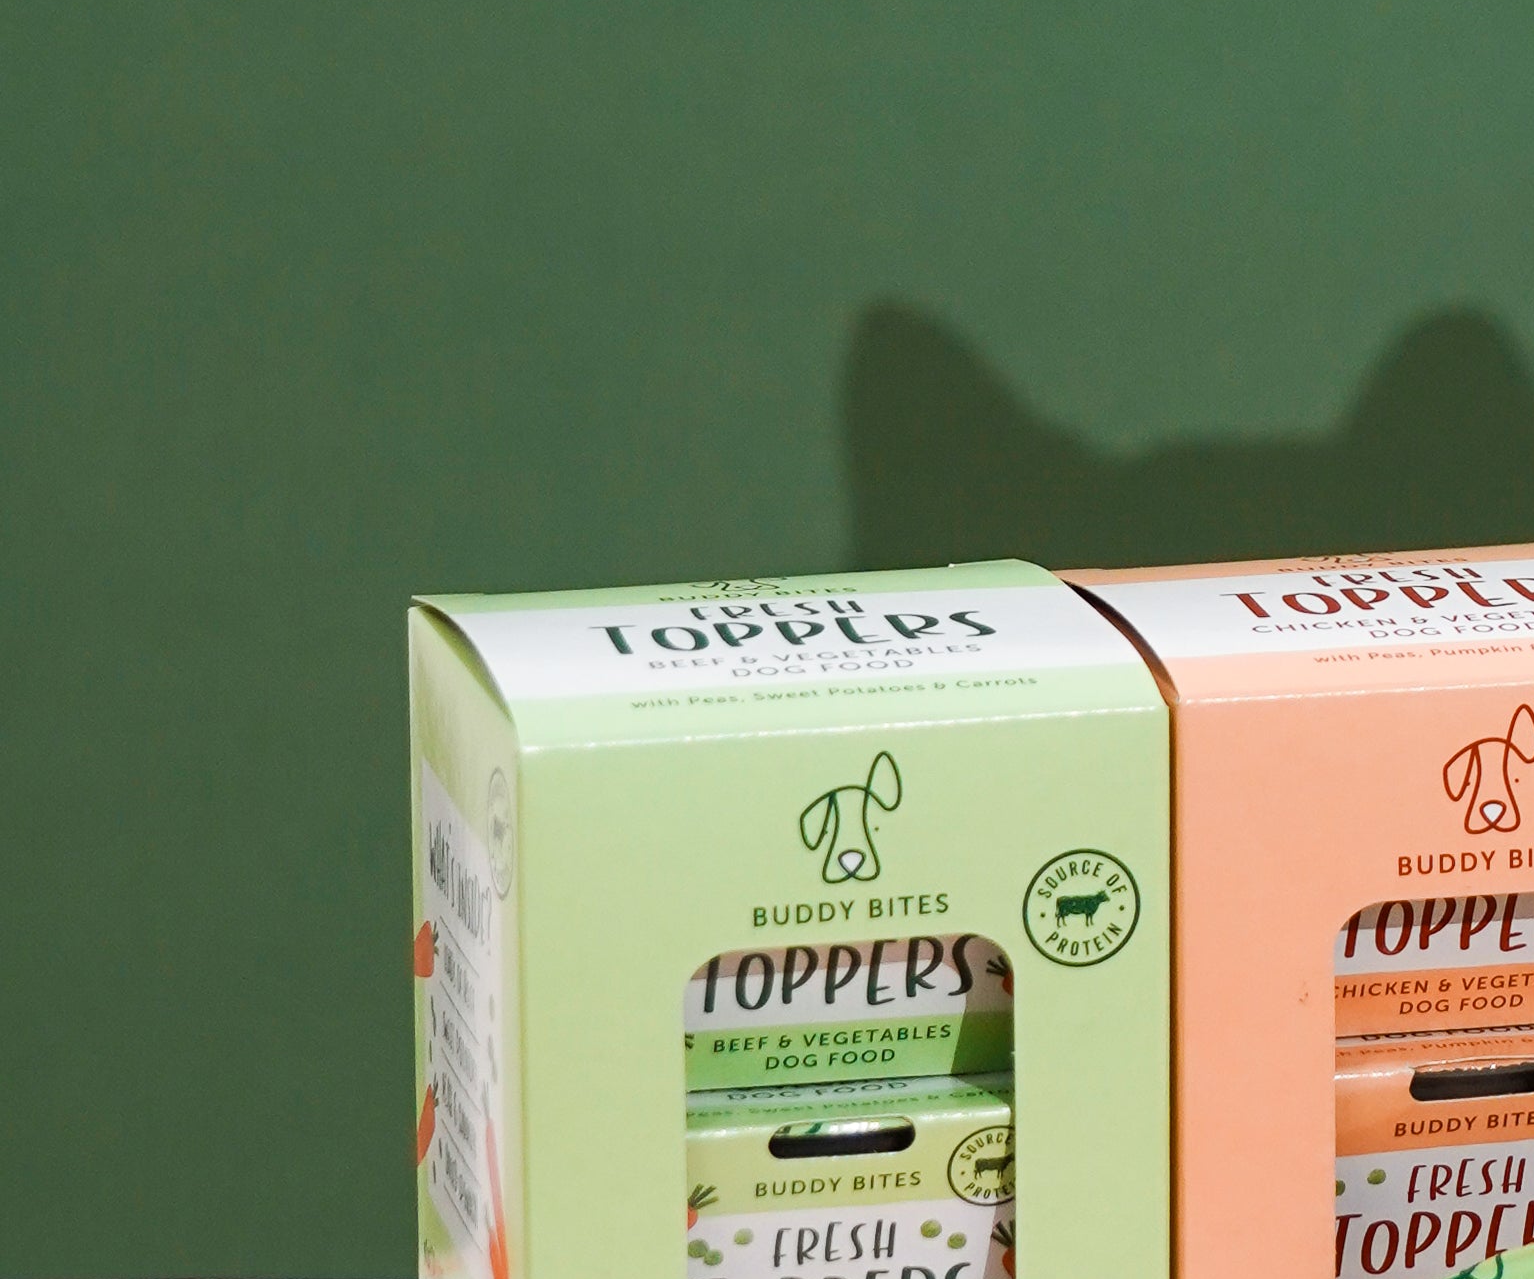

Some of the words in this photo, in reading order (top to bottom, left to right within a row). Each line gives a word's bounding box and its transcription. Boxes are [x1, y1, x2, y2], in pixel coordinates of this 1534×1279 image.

[1312, 568, 1482, 587] FRESH
[690, 600, 865, 621] FRESH
[588, 610, 997, 655] TOPPERS
[1252, 618, 1397, 633] CHICKEN
[1411, 617, 1428, 625] &
[1370, 627, 1442, 638] DOG
[649, 657, 726, 669] BEEF
[741, 655, 758, 664] &
[773, 644, 982, 662] VEGETABLES
[1314, 654, 1360, 663] with
[1368, 652, 1423, 660] Peas,
[1430, 644, 1522, 656] Pumpkin
[732, 665, 806, 678] DOG
[821, 659, 914, 672] FOOD
[631, 698, 680, 709] with
[688, 695, 745, 705] Peas,
[753, 690, 819, 701] Sweet
[829, 684, 925, 697] Potatoes
[934, 682, 946, 690] &
[956, 677, 1038, 689] Carrots
[1398, 850, 1496, 876] BUDDY
[1037, 859, 1104, 899] SOURCE
[1106, 873, 1128, 894] OF
[753, 900, 855, 927] BUDDY
[868, 894, 950, 918] BITES
[1045, 922, 1123, 956] PROTEIN
[703, 934, 979, 1013] TOPPERS
[1438, 978, 1452, 992] &
[1399, 999, 1450, 1015] DOG
[1459, 994, 1524, 1012] FOOD
[713, 1035, 769, 1053] BEEF
[778, 1033, 791, 1048] &
[802, 1024, 952, 1048] VEGETABLES
[764, 1051, 819, 1071] DOG
[828, 1047, 896, 1067] FOOD
[1394, 1117, 1477, 1137] BUDDY
[755, 1177, 842, 1198] BUDDY
[853, 1171, 922, 1191] BITES
[1408, 1155, 1526, 1204] FRESH
[773, 1219, 897, 1268] FRESH
